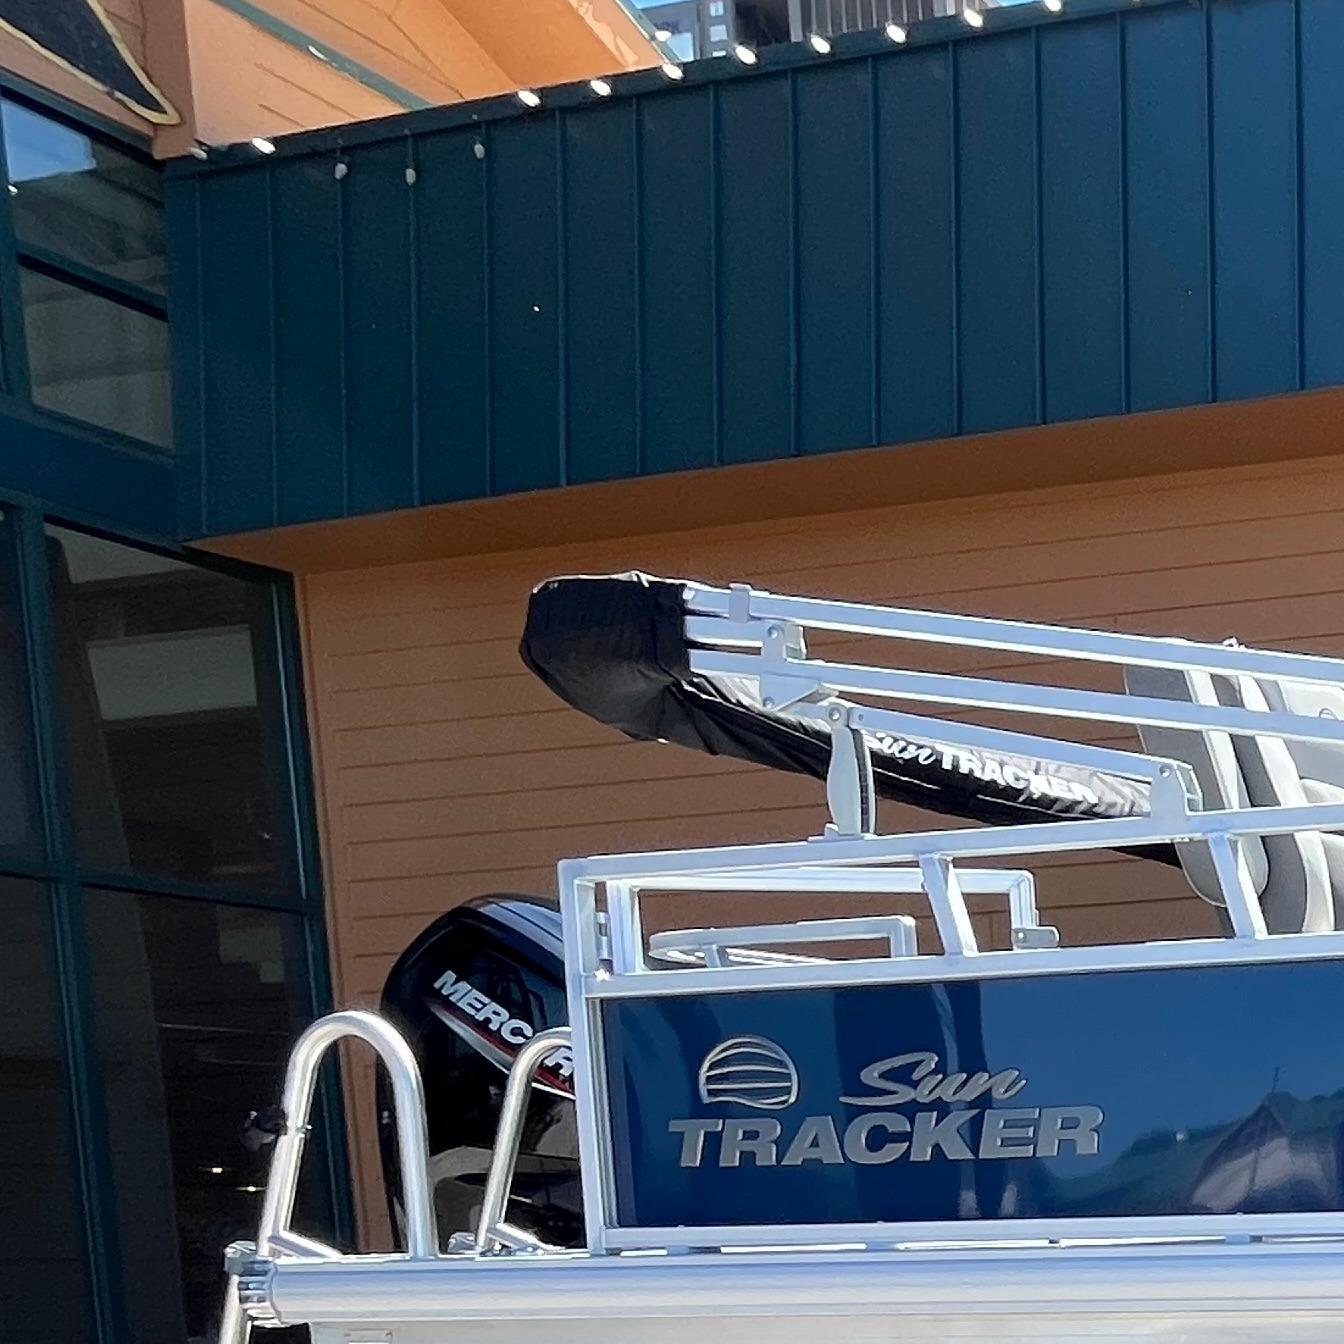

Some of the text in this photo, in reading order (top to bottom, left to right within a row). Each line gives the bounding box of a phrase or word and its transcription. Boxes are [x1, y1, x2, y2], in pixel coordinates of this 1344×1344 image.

[933, 741, 1099, 804] TRACKER
[432, 969, 575, 1078] MERCR
[838, 1050, 1028, 1106] Sun
[667, 1104, 1106, 1169] TRACKER
